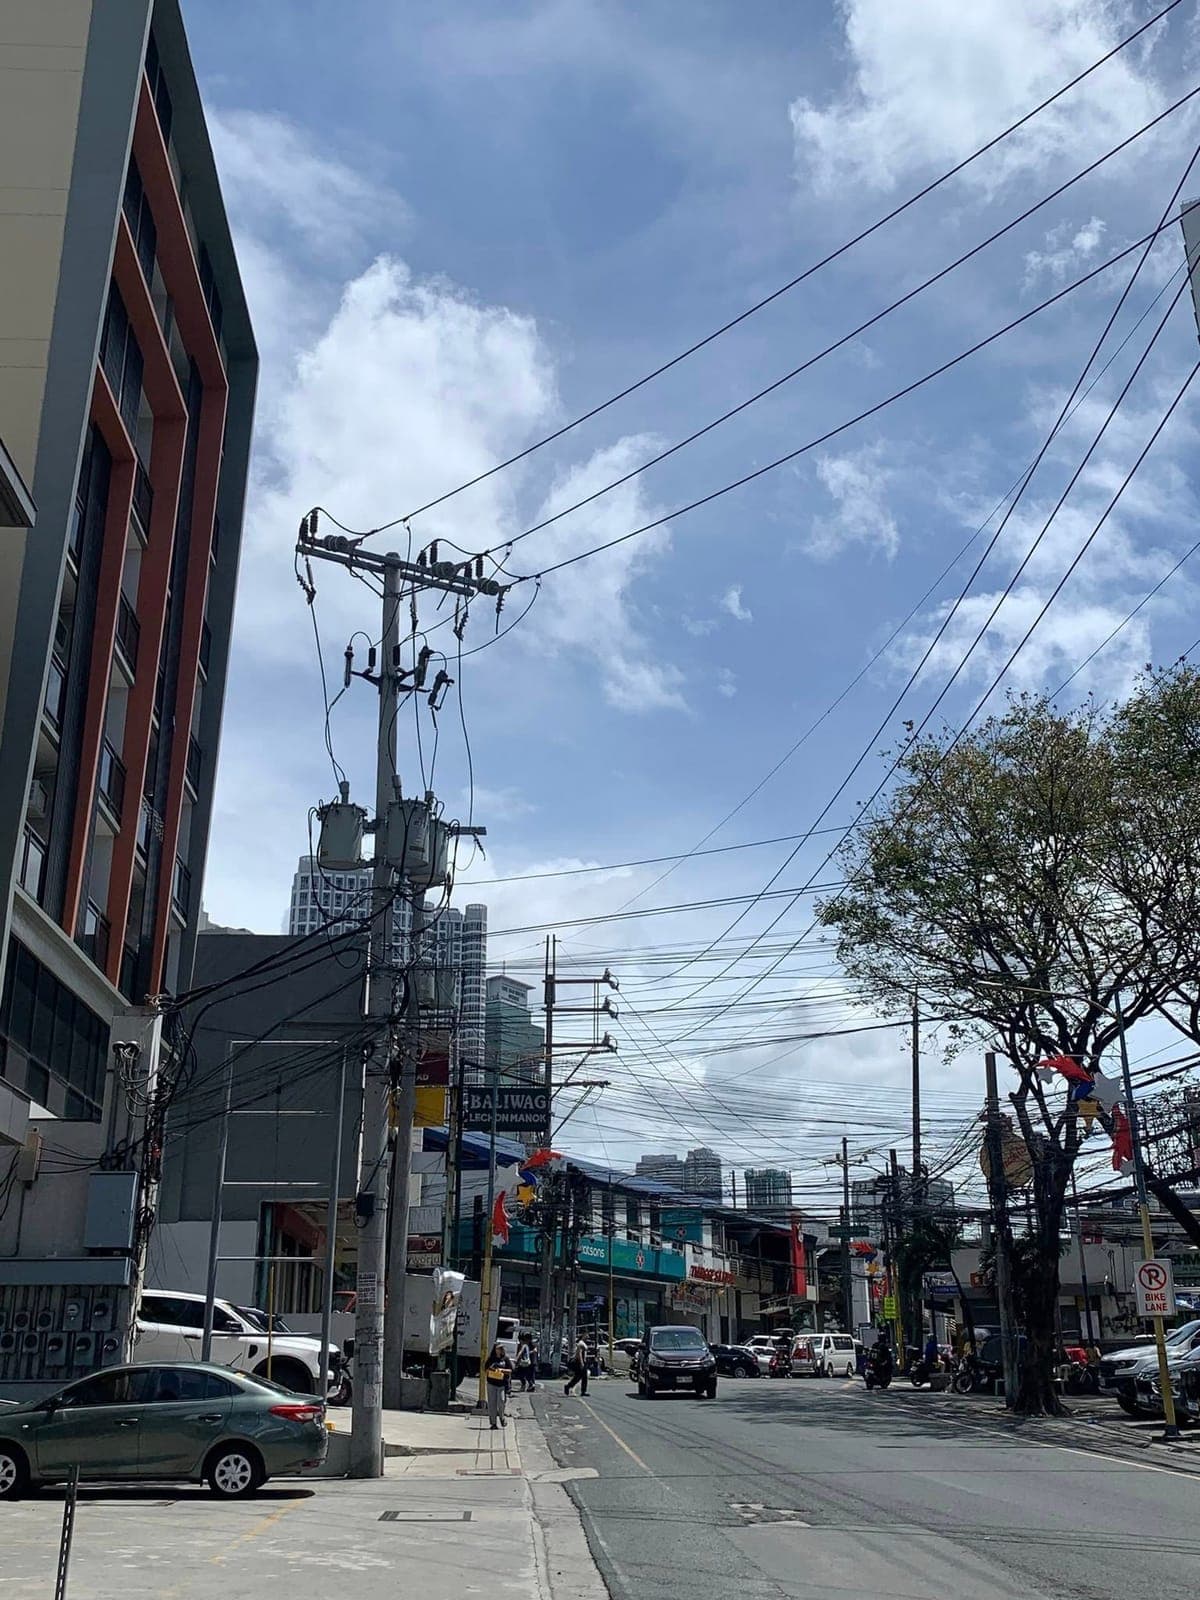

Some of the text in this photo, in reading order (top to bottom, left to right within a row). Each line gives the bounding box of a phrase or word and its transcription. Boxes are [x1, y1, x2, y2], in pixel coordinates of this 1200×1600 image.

[470, 1094, 547, 1109] BALIWAG
[469, 1113, 547, 1122] LECHON MANOK
[1144, 1293, 1166, 1301] BIKE
[1145, 1303, 1168, 1311] LANE
